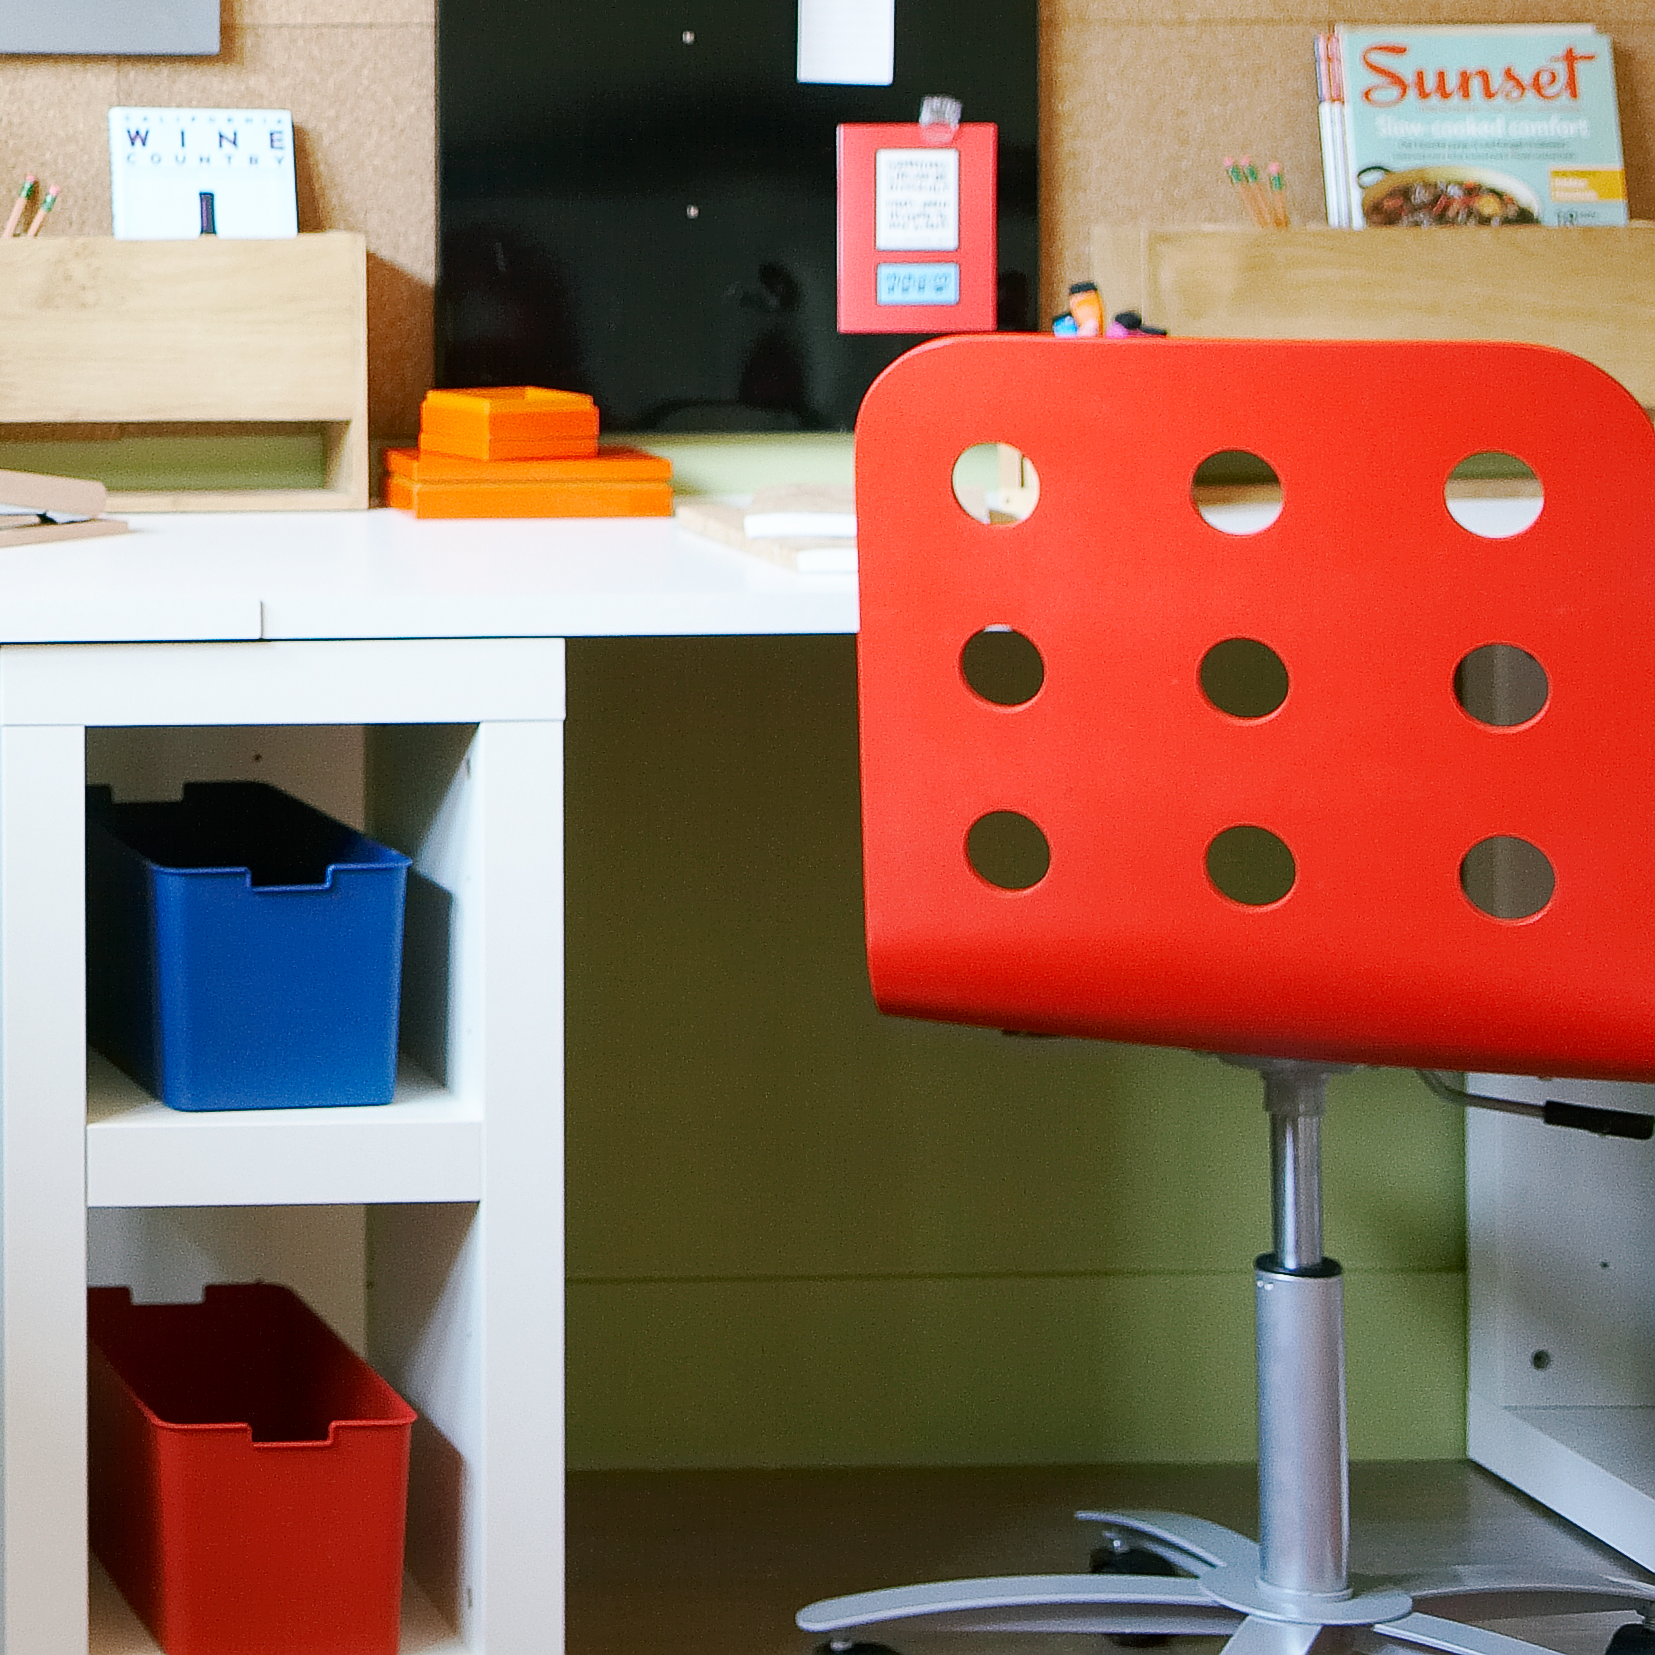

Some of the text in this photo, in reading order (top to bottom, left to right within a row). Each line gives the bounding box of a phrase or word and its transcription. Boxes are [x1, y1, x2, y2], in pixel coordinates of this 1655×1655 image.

[1361, 44, 1596, 108] Sunset
[126, 128, 286, 150] WINE
[126, 153, 285, 166] COUNTRY
